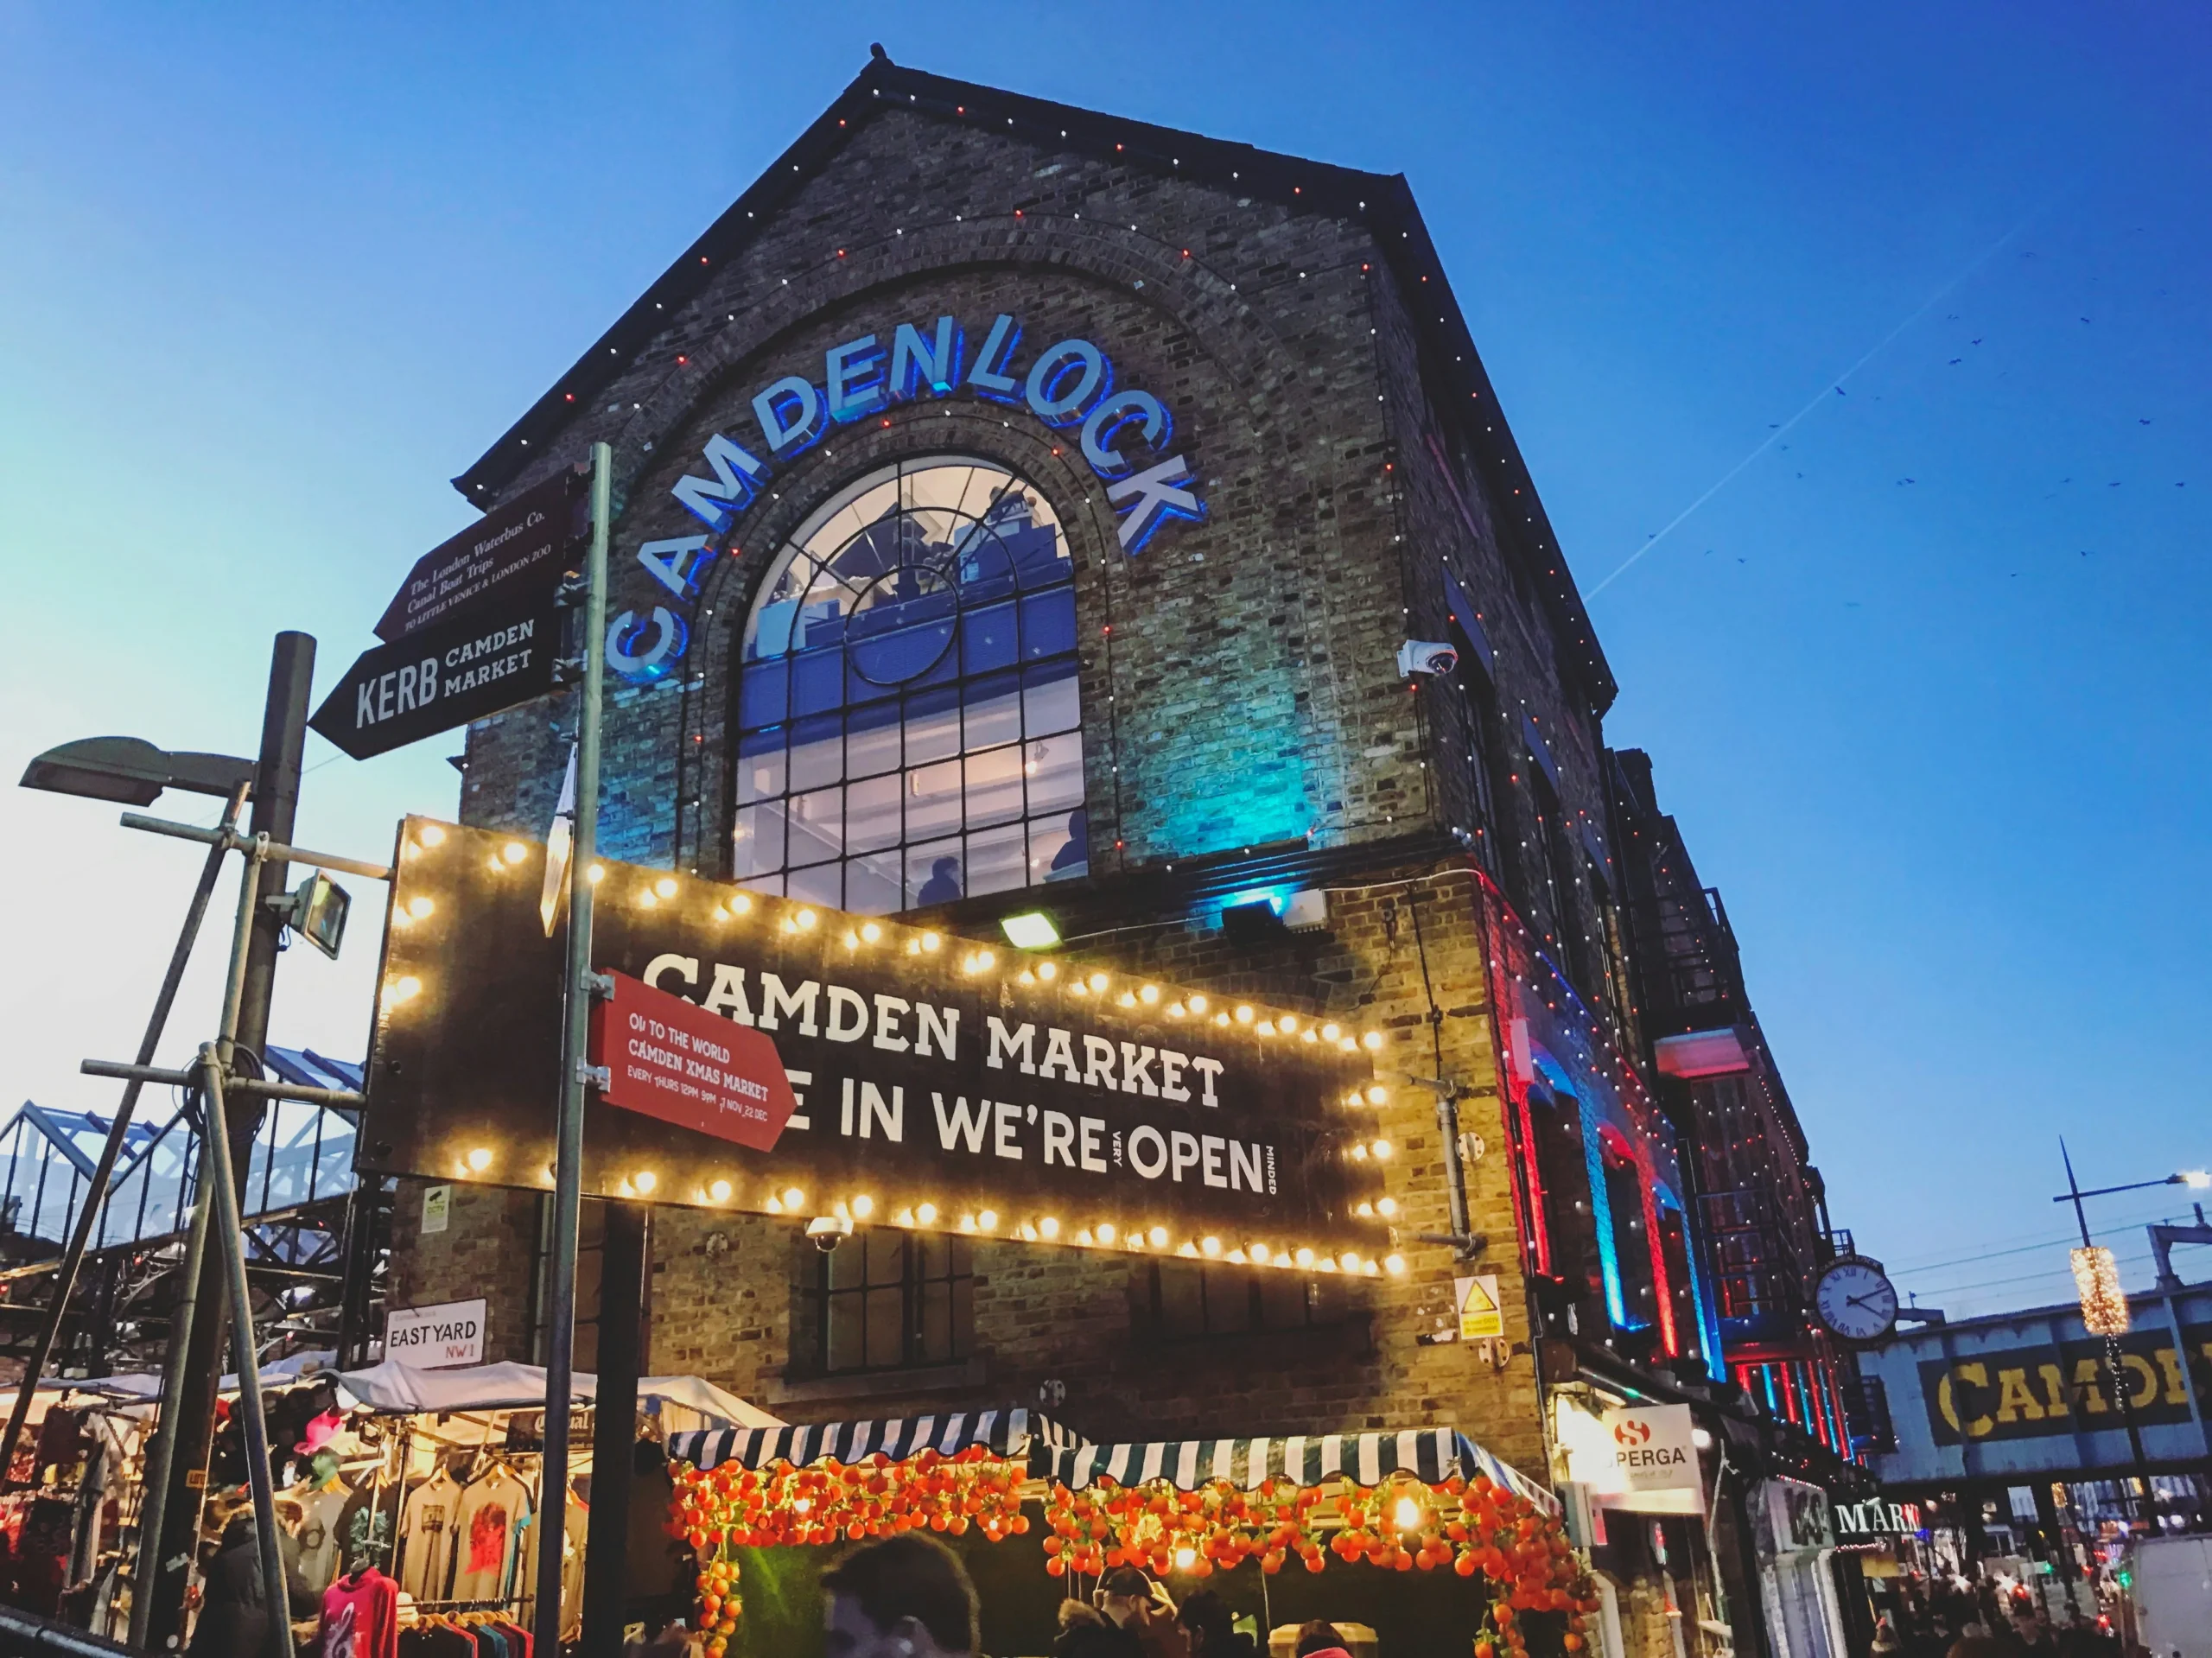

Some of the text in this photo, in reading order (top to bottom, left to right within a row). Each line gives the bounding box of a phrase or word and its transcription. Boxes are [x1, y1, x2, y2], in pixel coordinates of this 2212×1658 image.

[605, 313, 1205, 677] CAMDEN LOCK
[410, 511, 545, 596] The London Waterbus Co.
[404, 543, 551, 632] TO LITTLE VENICE & LONDON ZOO
[407, 557, 494, 613] Canal Boat Trips
[445, 619, 535, 668] CAMDEN
[356, 657, 438, 728] KERB
[443, 649, 533, 697] MARKET
[644, 953, 1224, 1109] CAMDEN MARKET
[649, 1020, 665, 1039] TO
[668, 1026, 689, 1049] THE
[692, 1036, 730, 1064] WORLD
[627, 1064, 652, 1083] EVERY
[654, 1076, 679, 1092] THURS
[701, 1090, 716, 1104] 9PM
[727, 1099, 743, 1114] NOV
[754, 1109, 768, 1121] DEC
[628, 1039, 683, 1071] CAMDEN
[686, 1058, 721, 1085] XMAS
[723, 1072, 768, 1102] MARKET
[840, 1077, 904, 1143] IN
[931, 1091, 1107, 1173] WE'RE
[1128, 1125, 1264, 1193] OPEN
[1113, 1130, 1122, 1168] VERY
[1266, 1145, 1277, 1196] MINDED
[391, 1321, 477, 1347] EAST YARD
[1608, 1447, 1687, 1468] PERGA
